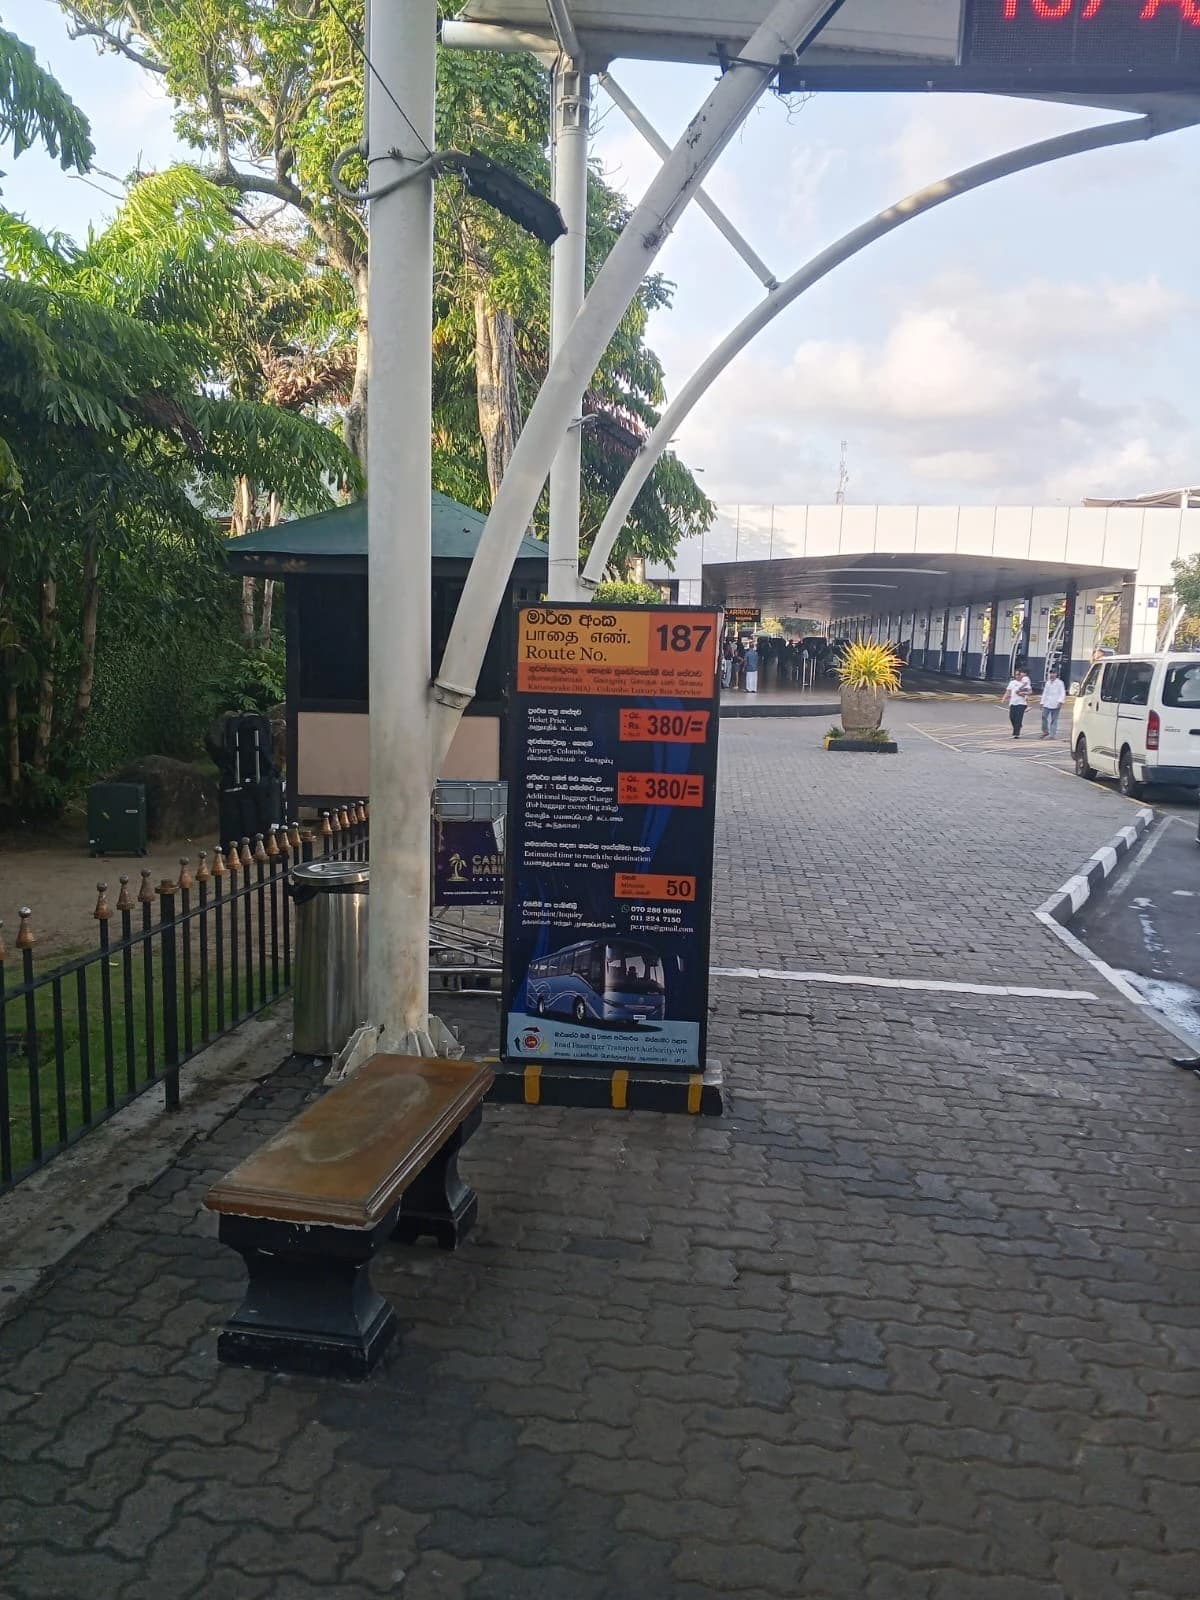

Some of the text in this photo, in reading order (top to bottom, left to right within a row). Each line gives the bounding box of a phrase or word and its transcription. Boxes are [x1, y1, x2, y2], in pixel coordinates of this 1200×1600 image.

[526, 609, 617, 629] මාර්ග අංක
[526, 628, 631, 647] பாதை எண்.
[656, 624, 711, 652] 187
[526, 645, 608, 662] Route No.
[631, 687, 657, 696] Luxury
[528, 716, 567, 725] Ticket Price
[647, 715, 704, 737] 380/=
[527, 747, 552, 756] Airport
[557, 748, 587, 756] Colombo
[645, 778, 700, 800] 380/=
[526, 793, 560, 801] Additional
[562, 794, 588, 803] Baggage
[589, 795, 613, 804] Charge
[540, 802, 567, 811] baggage
[567, 803, 600, 812] exceeding
[524, 850, 558, 858] Estimated
[559, 852, 574, 860] time
[613, 854, 651, 862] destination
[667, 879, 692, 897] 50
[522, 909, 583, 919] Complaint/Inquiry
[662, 916, 682, 924] 7150
[554, 1041, 571, 1049] Road
[572, 1042, 605, 1051] Passenger
[606, 1044, 640, 1053] Transport
